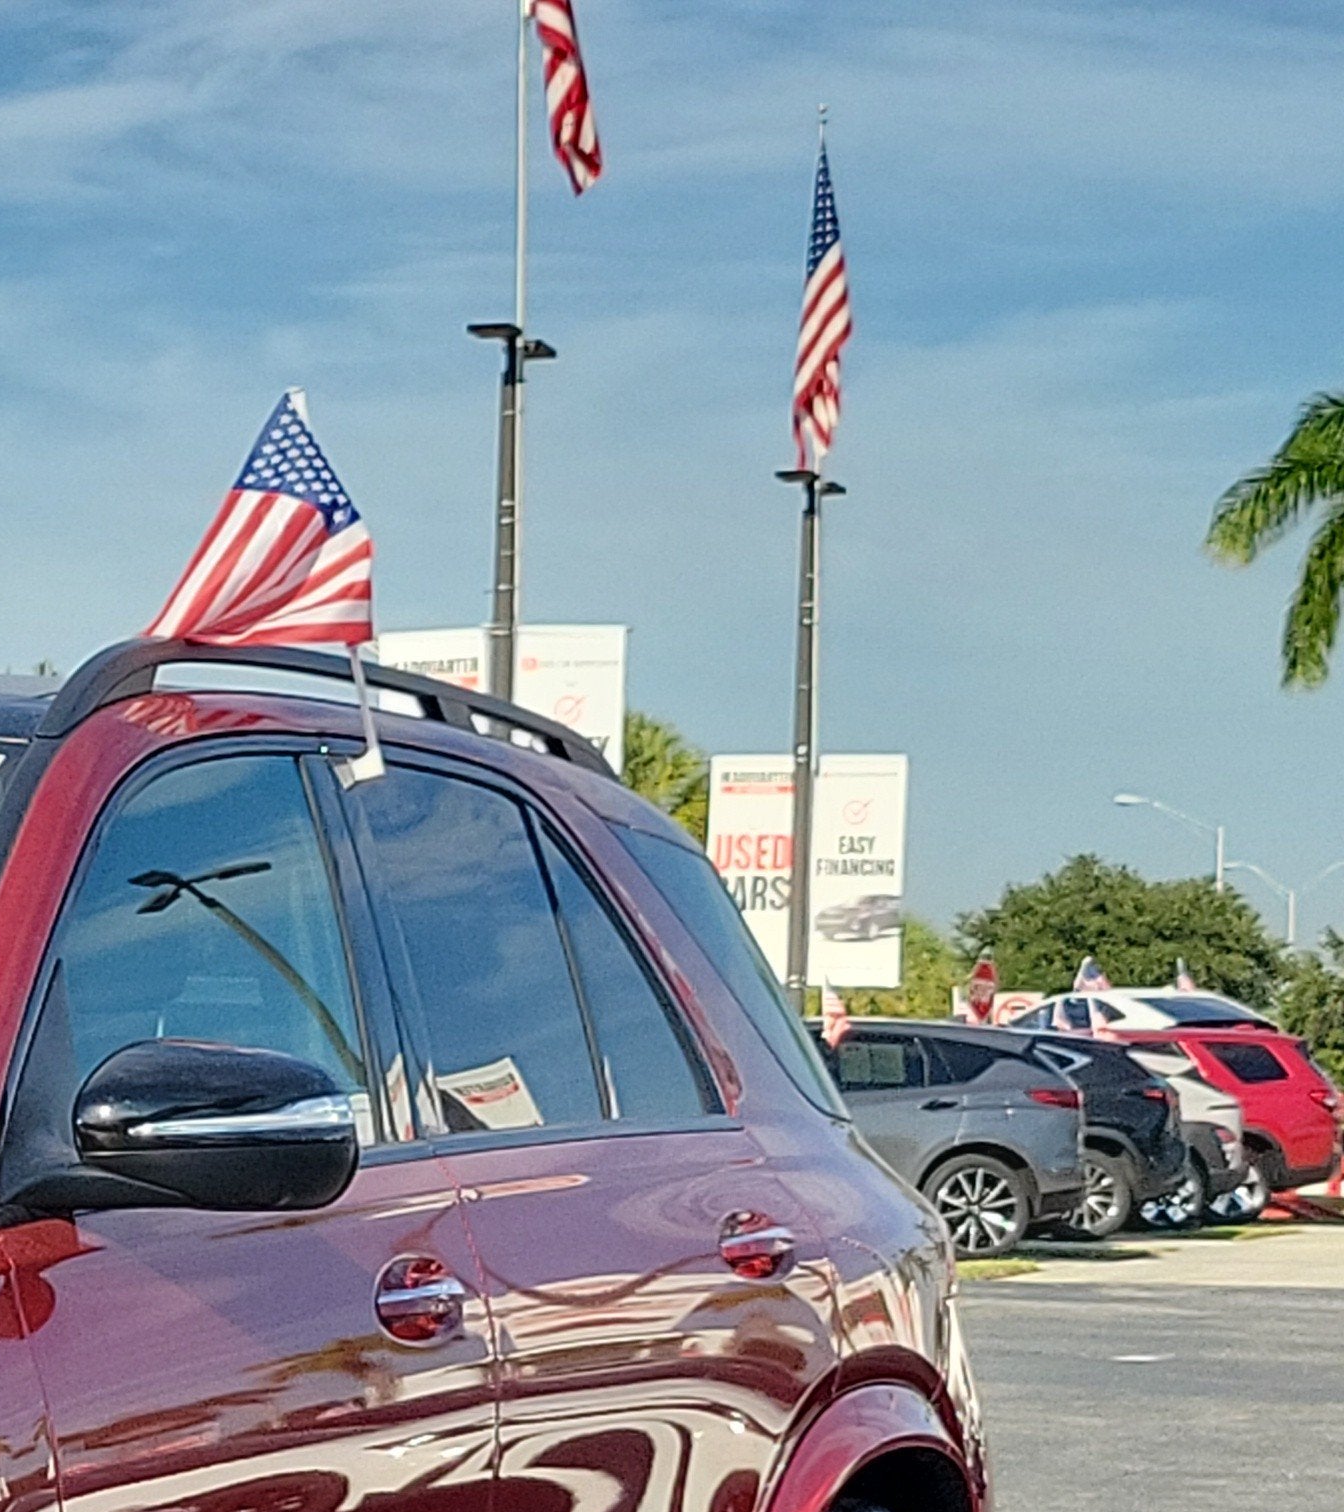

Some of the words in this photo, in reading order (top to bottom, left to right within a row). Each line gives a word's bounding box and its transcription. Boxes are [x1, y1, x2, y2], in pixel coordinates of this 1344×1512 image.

[715, 834, 794, 870] USED
[837, 836, 876, 854] EASY
[816, 859, 895, 876] FINANCING
